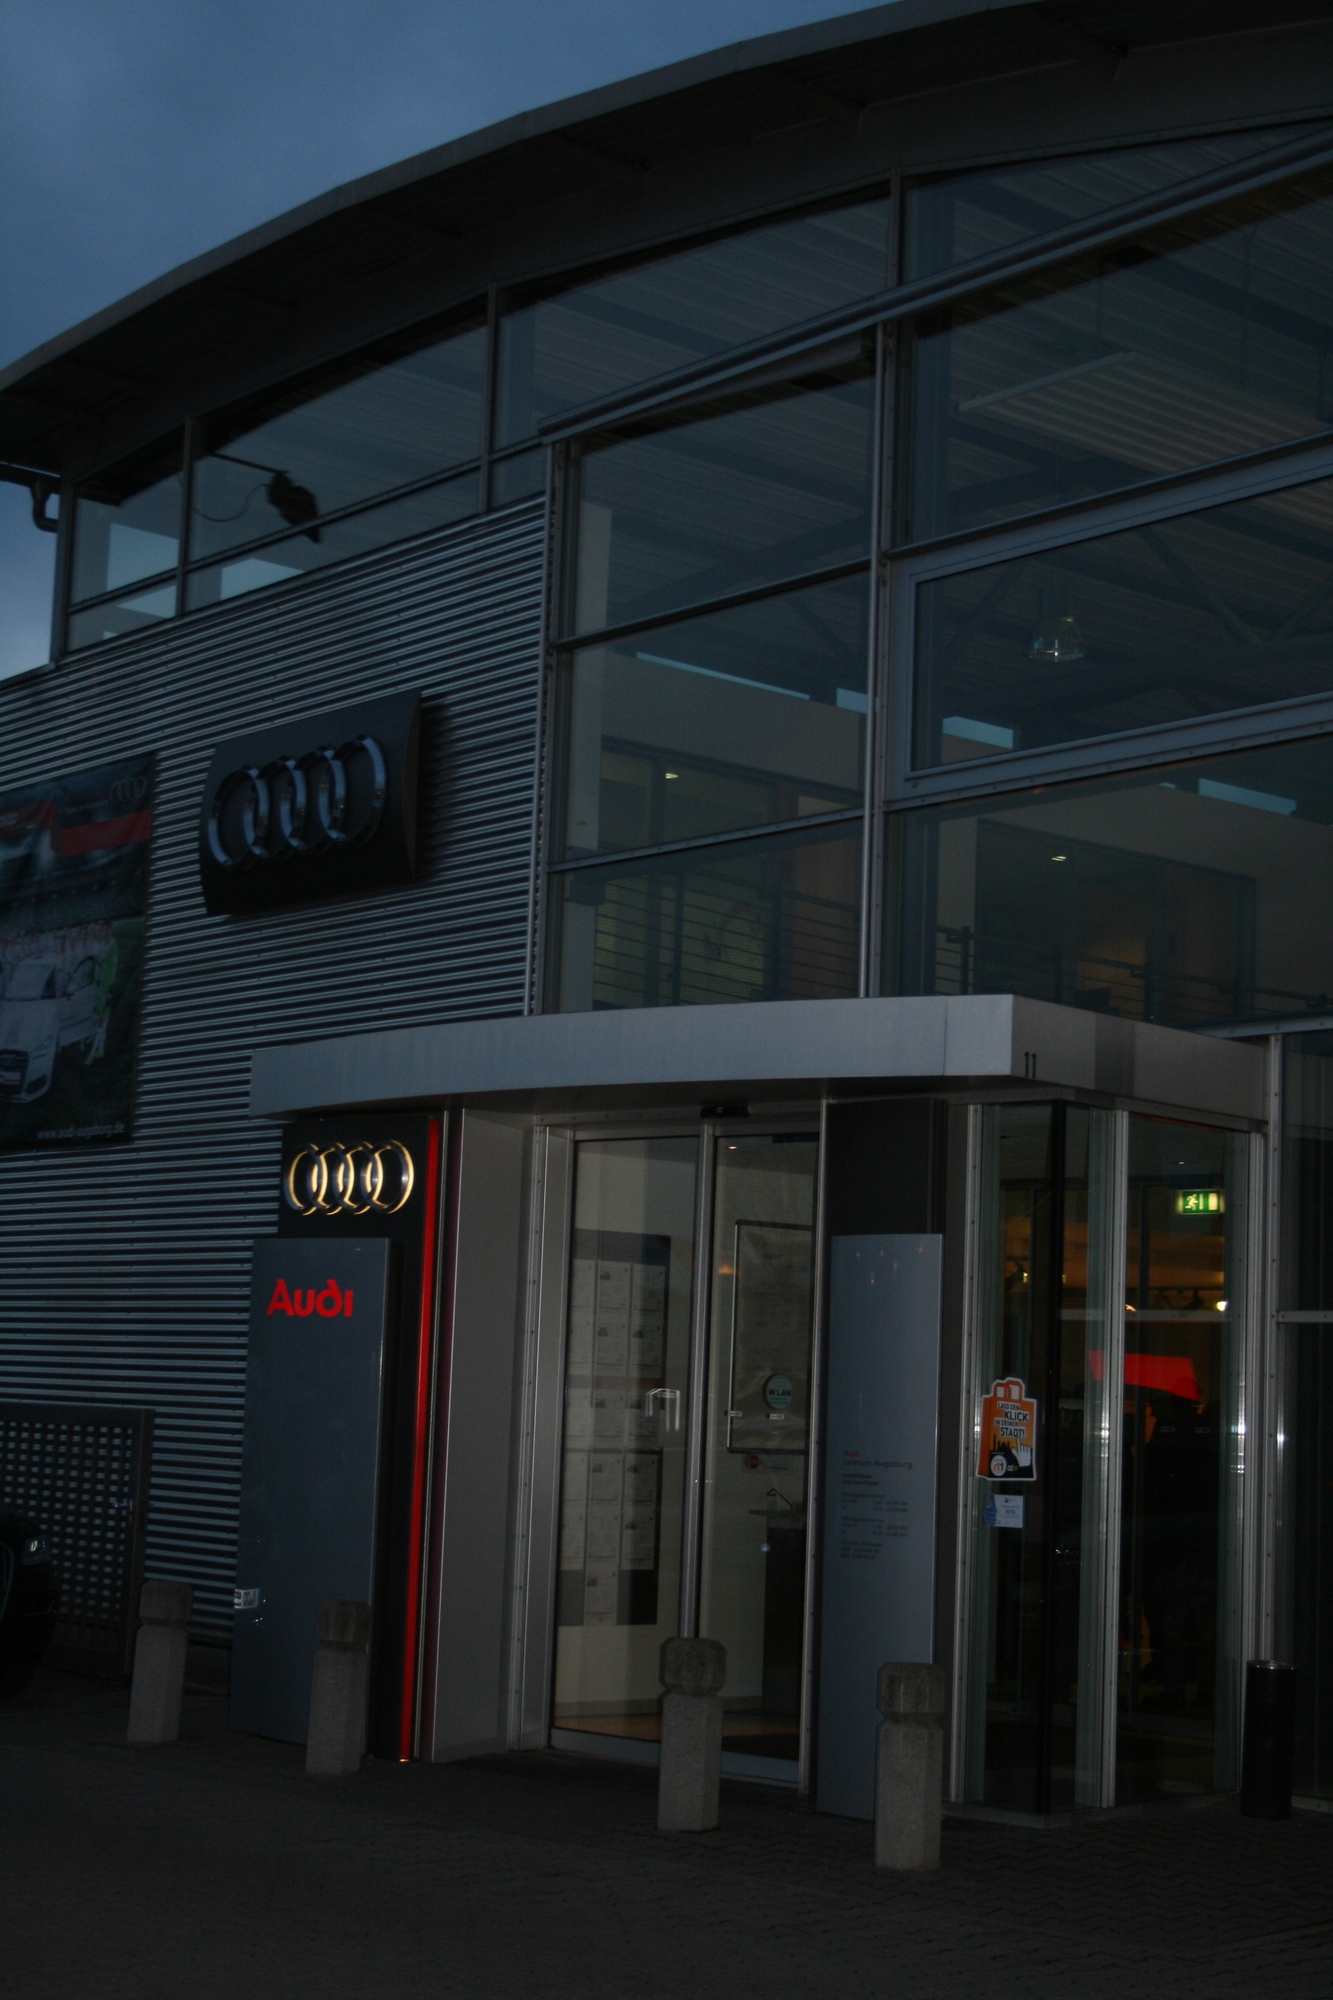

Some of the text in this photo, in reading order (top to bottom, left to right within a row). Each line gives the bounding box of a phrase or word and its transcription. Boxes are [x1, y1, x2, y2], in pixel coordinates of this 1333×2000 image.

[1024, 1051, 1036, 1079] 11
[266, 1278, 355, 1318] Audi
[998, 1402, 1020, 1411] LASS DEN
[1004, 1410, 1028, 1422] KLICK
[1001, 1419, 1019, 1427] DEINER
[1000, 1427, 1025, 1438] STADT!
[843, 1458, 912, 1469] Zentrum Augsburg
